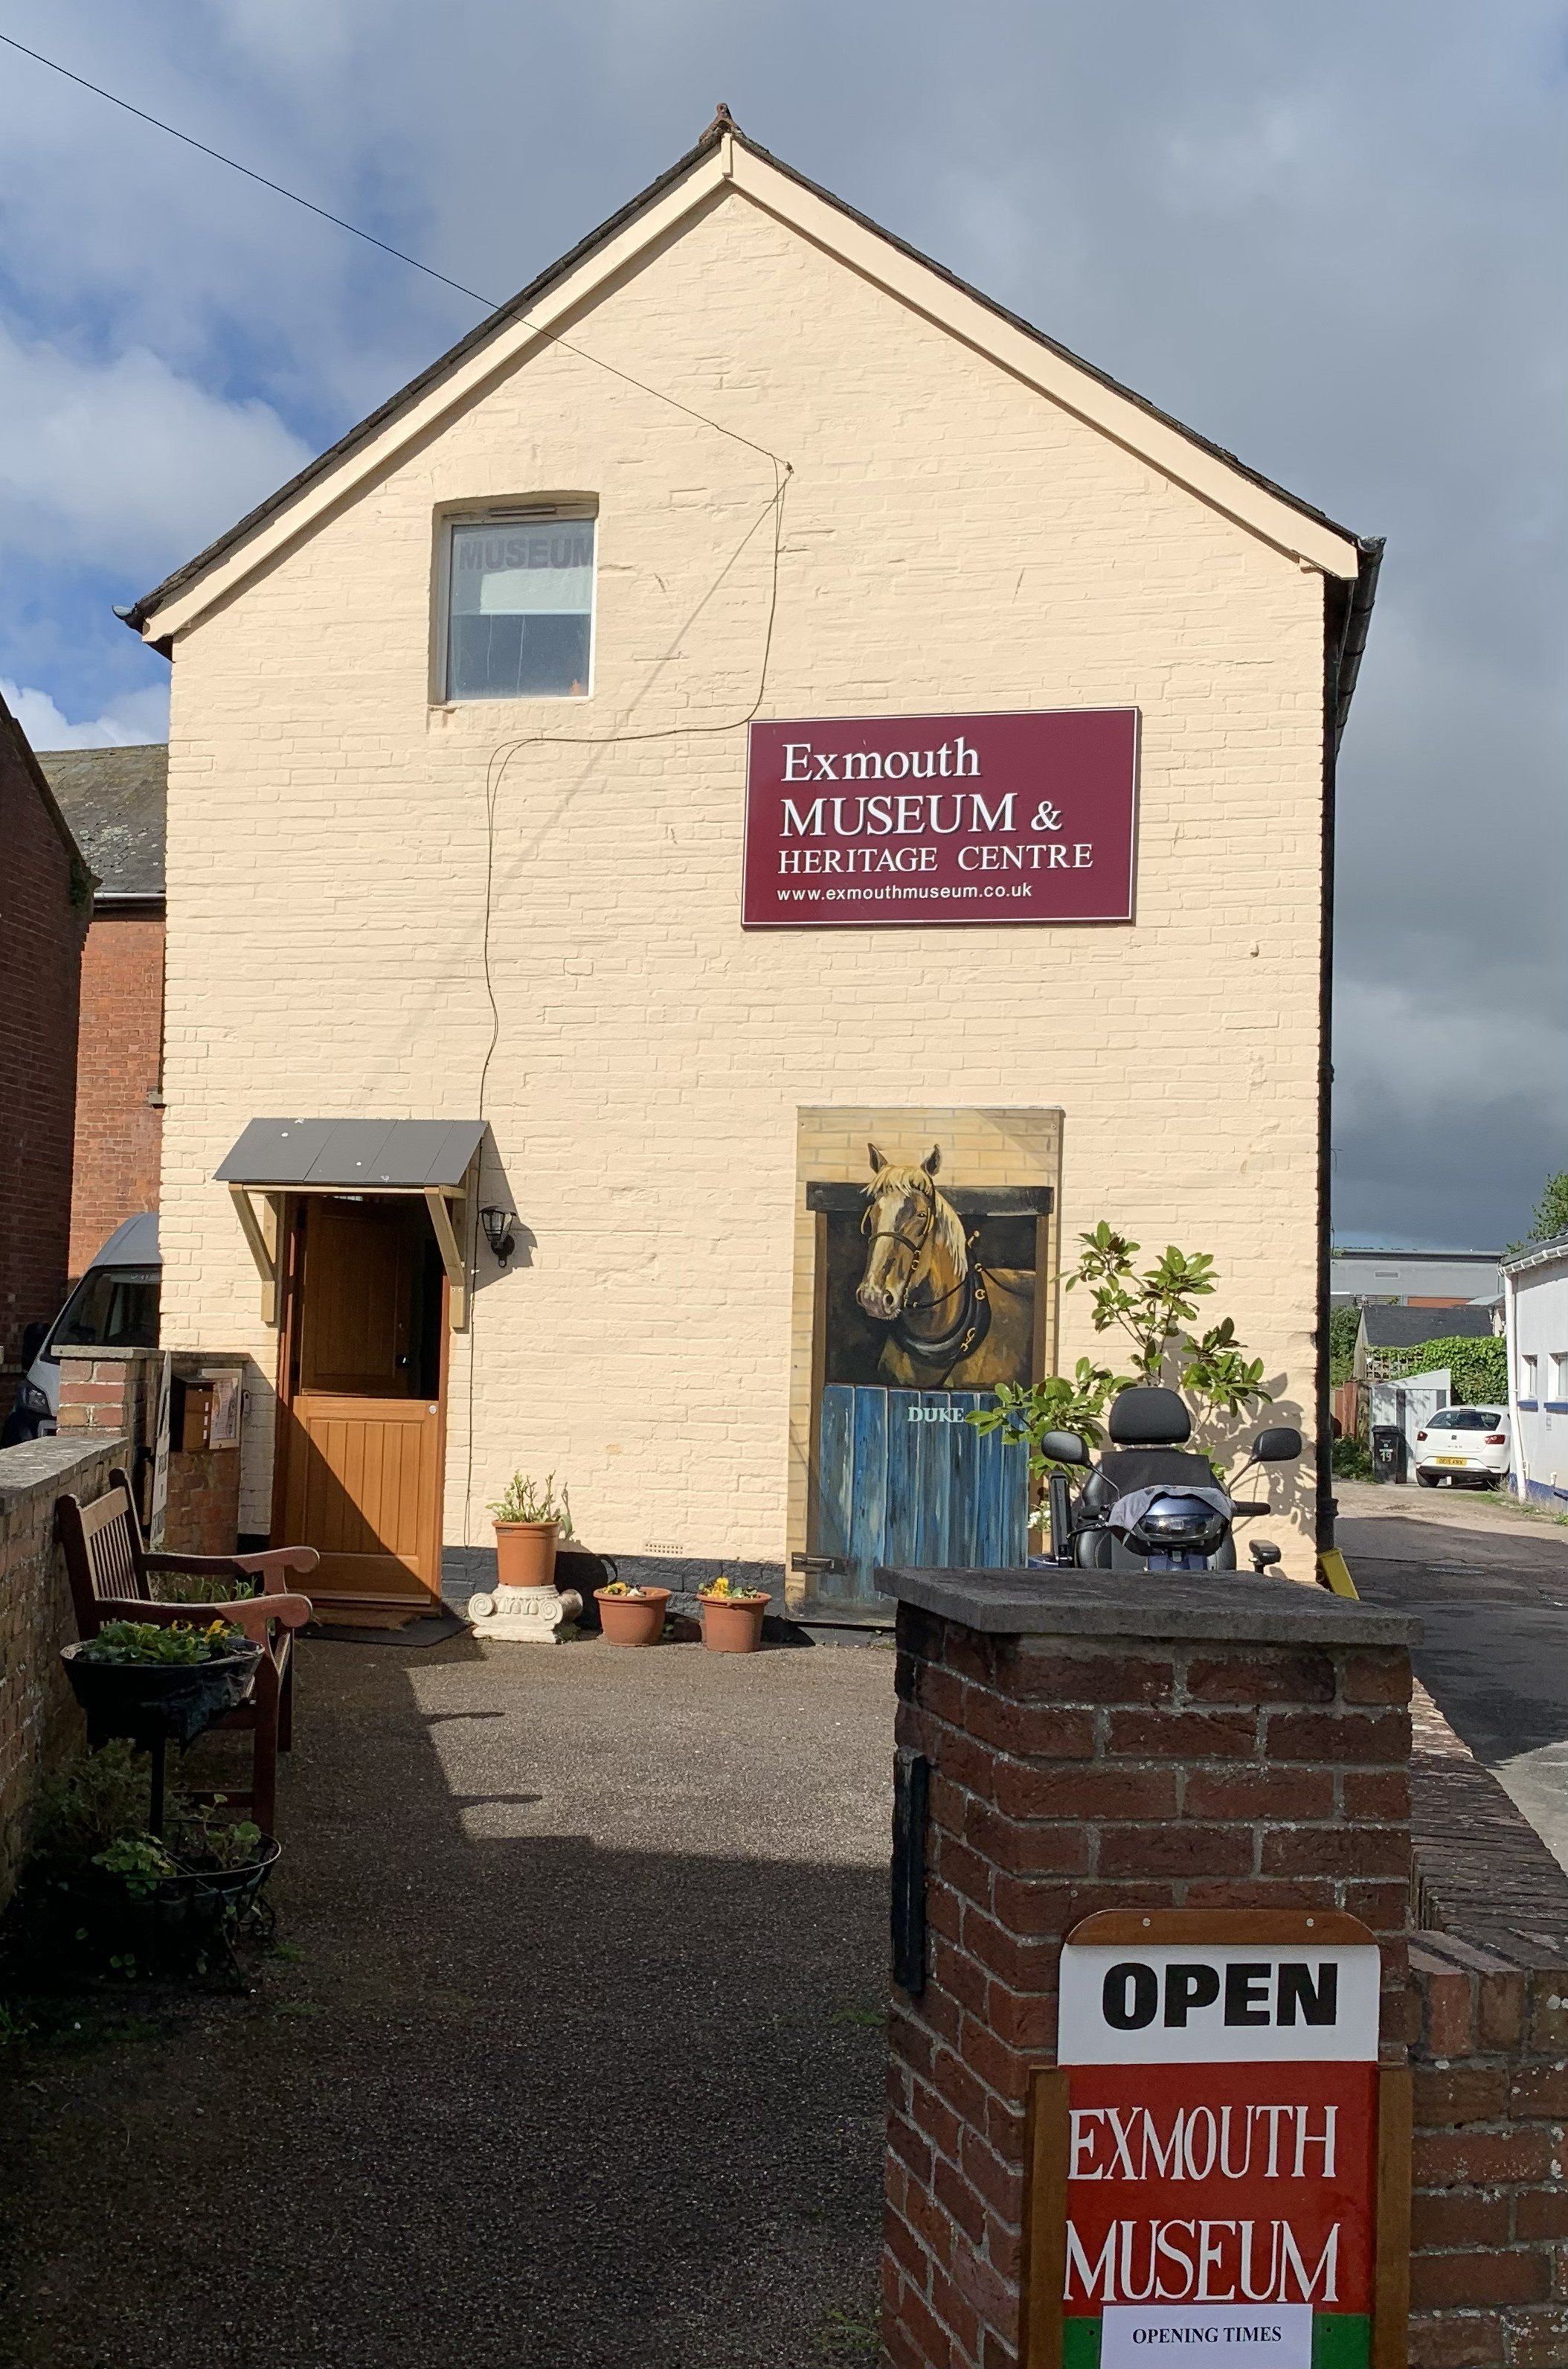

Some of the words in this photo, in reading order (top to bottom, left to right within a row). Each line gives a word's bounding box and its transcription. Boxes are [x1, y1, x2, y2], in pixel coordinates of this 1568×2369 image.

[458, 537, 593, 570] MUSEUM
[781, 737, 981, 781] Exmouth
[780, 793, 1018, 836] MUSEUM
[1031, 801, 1062, 831] &
[778, 847, 938, 873] HERITAGE
[957, 844, 1093, 871] CENTRE
[777, 882, 1032, 901] www.exmouthmuseum.co.uk
[907, 1406, 964, 1423] DUKE
[1380, 1452, 1392, 1462] 19
[1102, 1962, 1338, 2030] OPEN
[1067, 2105, 1339, 2181] EXMOUTH
[1063, 2219, 1341, 2303] MUSEUM
[1132, 2327, 1218, 2344] OPENING
[1223, 2326, 1282, 2342] TIMES
